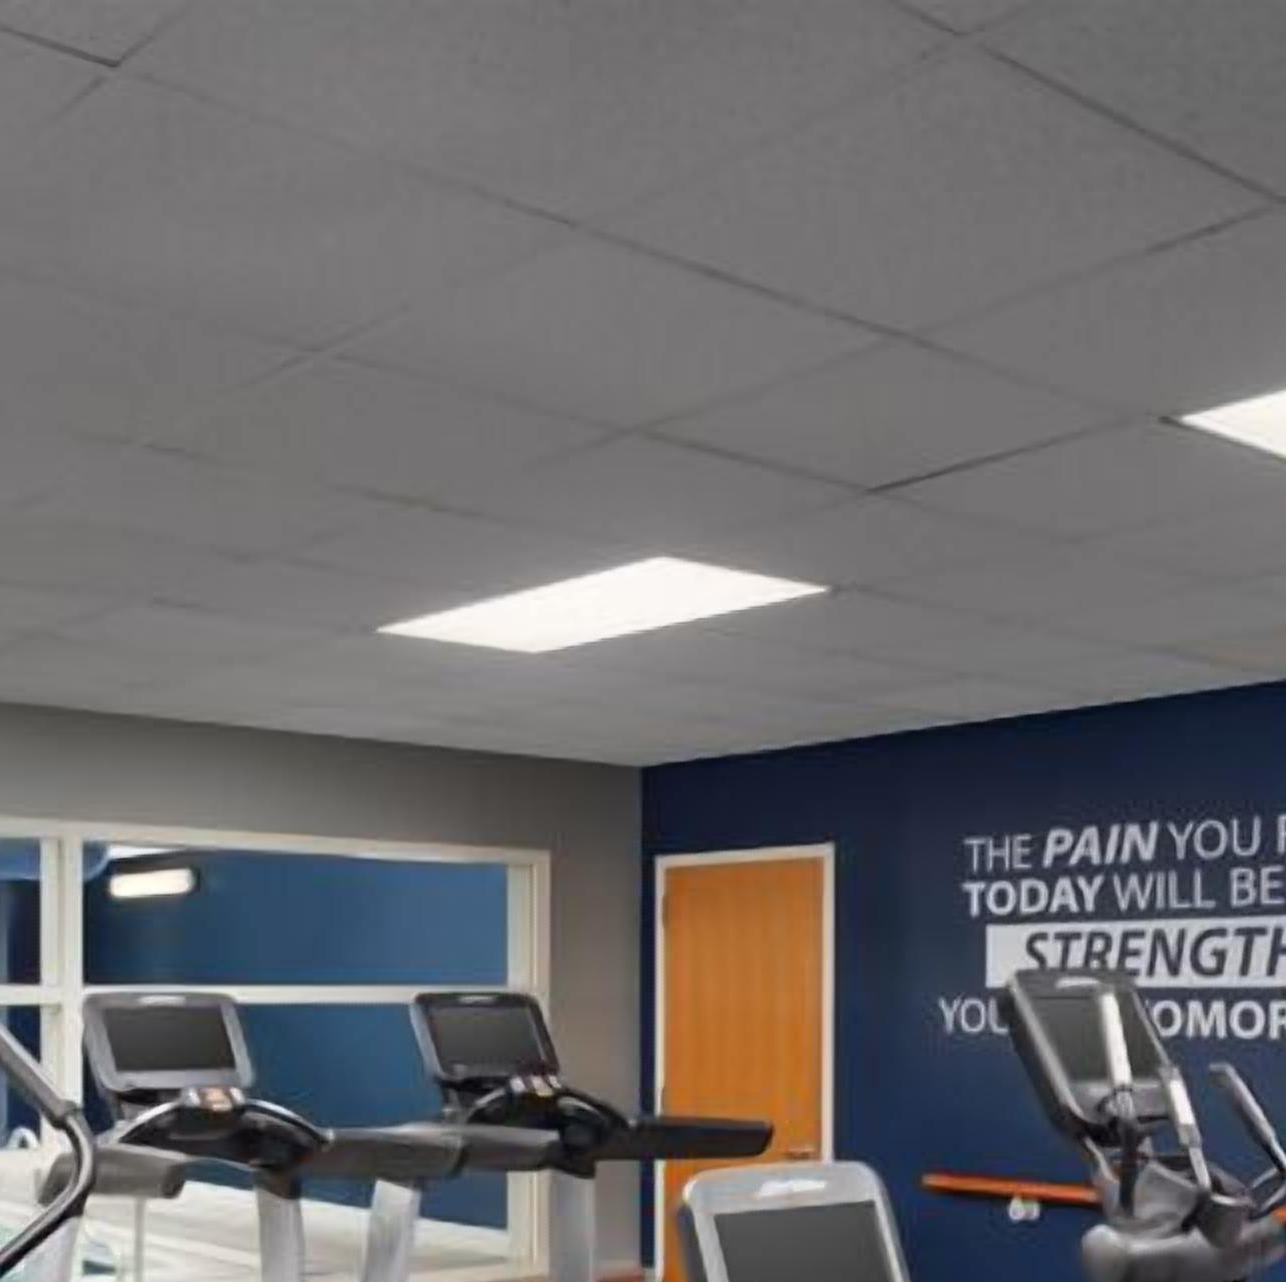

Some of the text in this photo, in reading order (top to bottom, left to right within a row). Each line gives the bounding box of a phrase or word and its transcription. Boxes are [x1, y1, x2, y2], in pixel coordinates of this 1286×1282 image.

[963, 833, 1032, 873] THE
[1042, 820, 1159, 868] PAIN
[1168, 814, 1261, 860] YOU
[962, 874, 1105, 917] TODAY
[1113, 867, 1216, 912] WILL
[1230, 865, 1285, 907] BE
